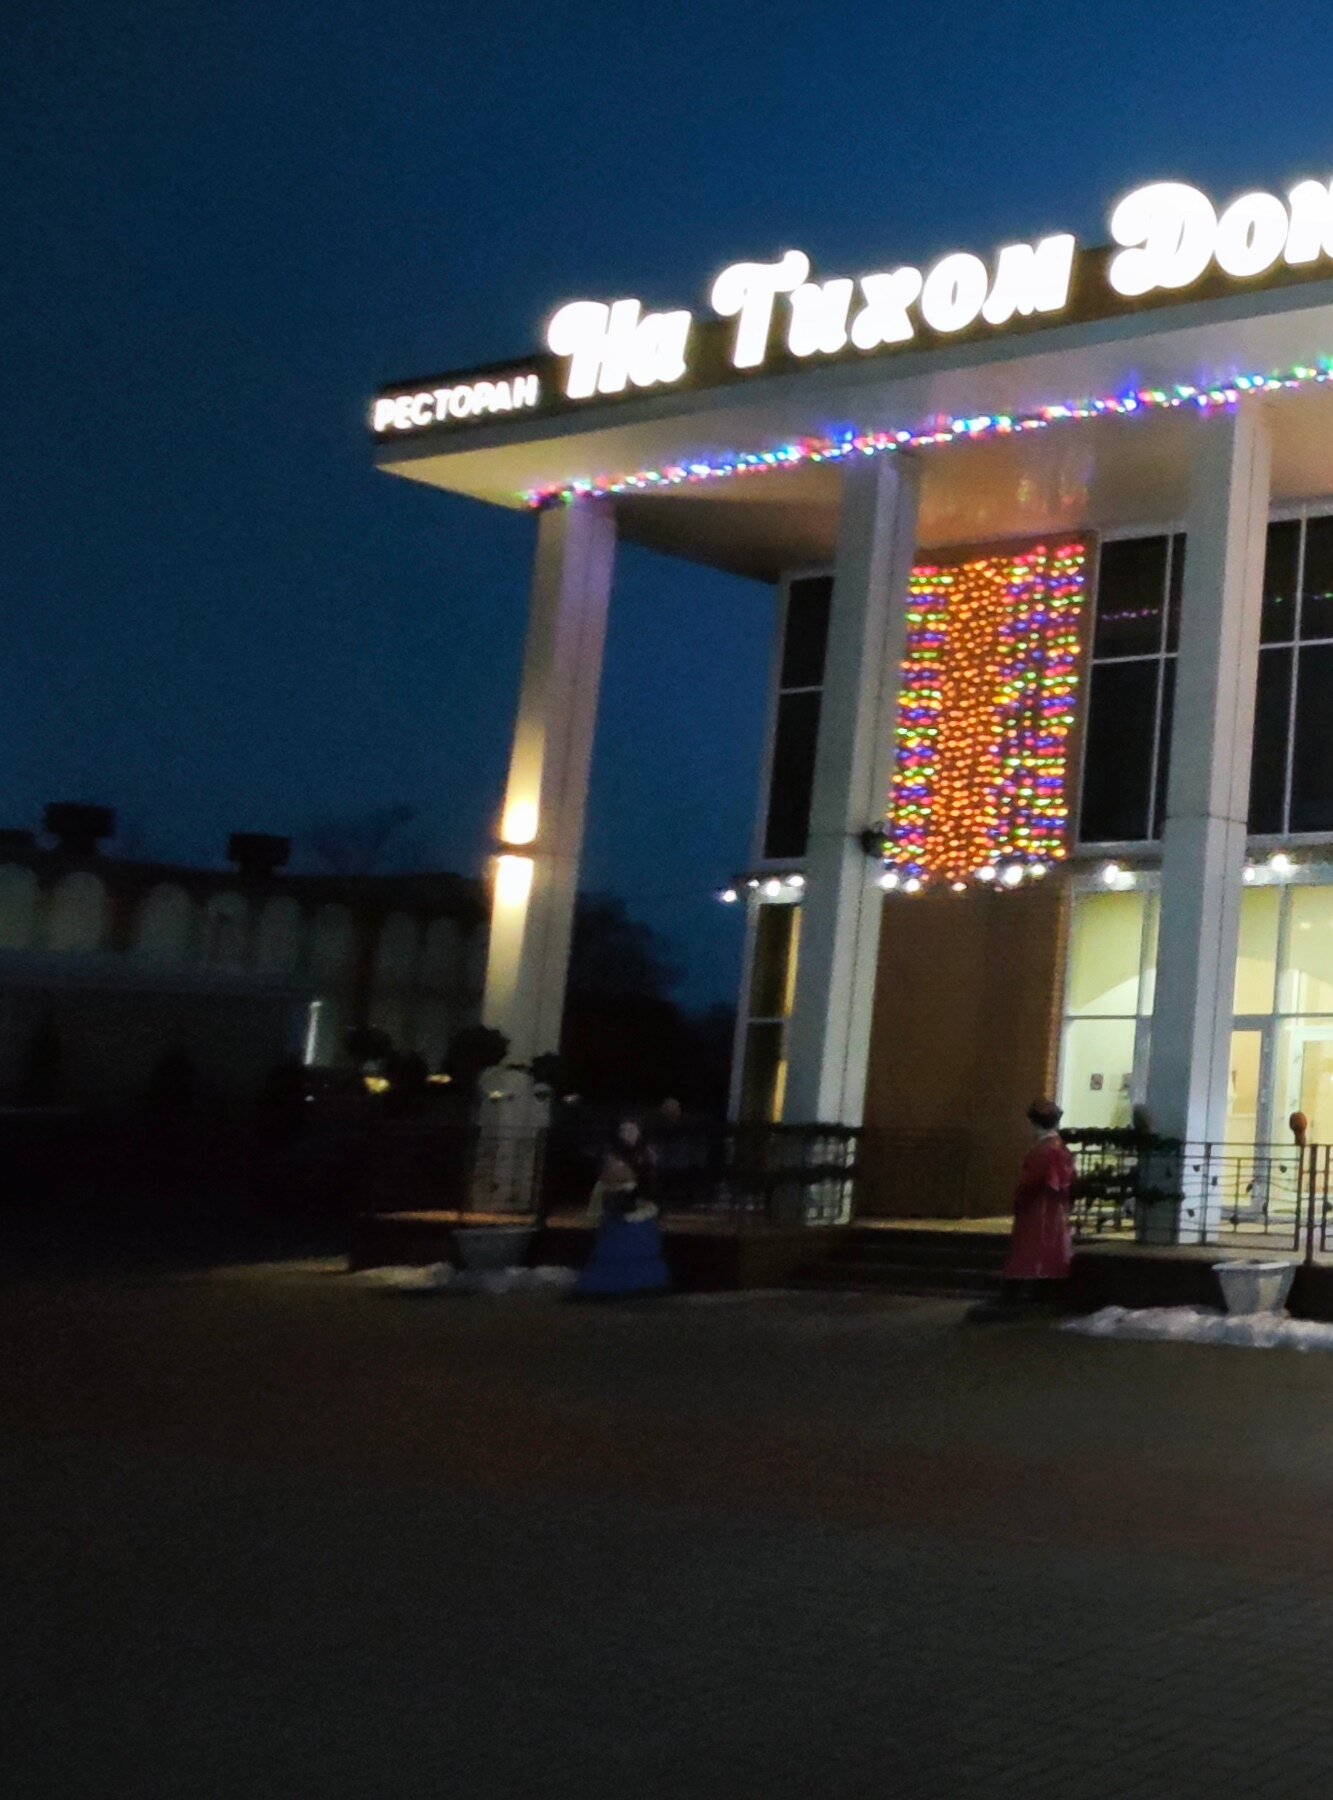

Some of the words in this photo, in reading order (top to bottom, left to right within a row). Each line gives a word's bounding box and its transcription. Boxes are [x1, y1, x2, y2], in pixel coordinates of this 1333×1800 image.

[546, 298, 692, 399] На
[710, 233, 1076, 369] Тихом
[372, 373, 539, 432] РЕСТОРАН
